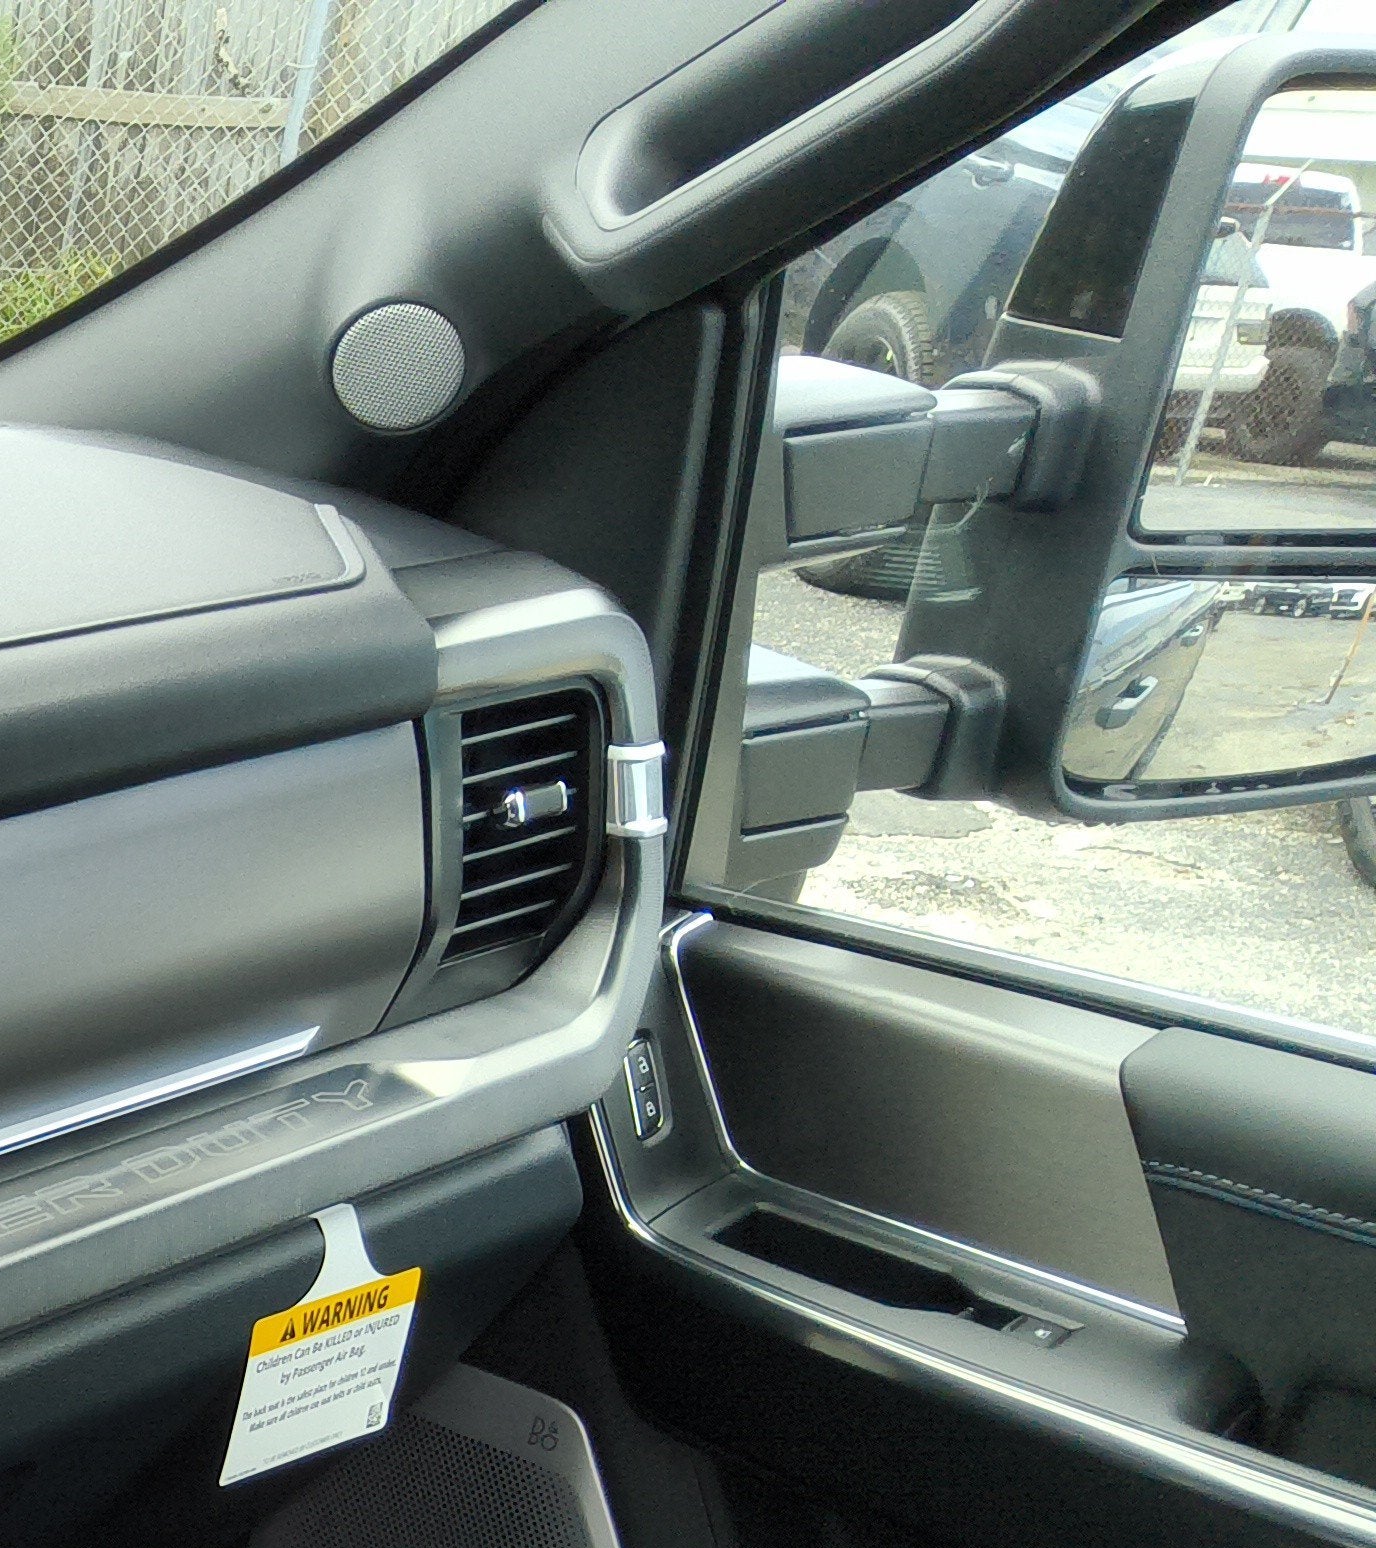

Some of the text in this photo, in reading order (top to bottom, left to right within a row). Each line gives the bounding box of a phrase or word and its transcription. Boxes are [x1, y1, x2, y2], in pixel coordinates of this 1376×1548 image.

[120, 1078, 375, 1185] DUTY
[302, 1285, 390, 1336] WARNING
[256, 1353, 293, 1374] Children
[294, 1346, 311, 1360] Can
[325, 1329, 353, 1350] KILLED
[364, 1314, 400, 1336] INJURED
[292, 1355, 335, 1381] Passenger
